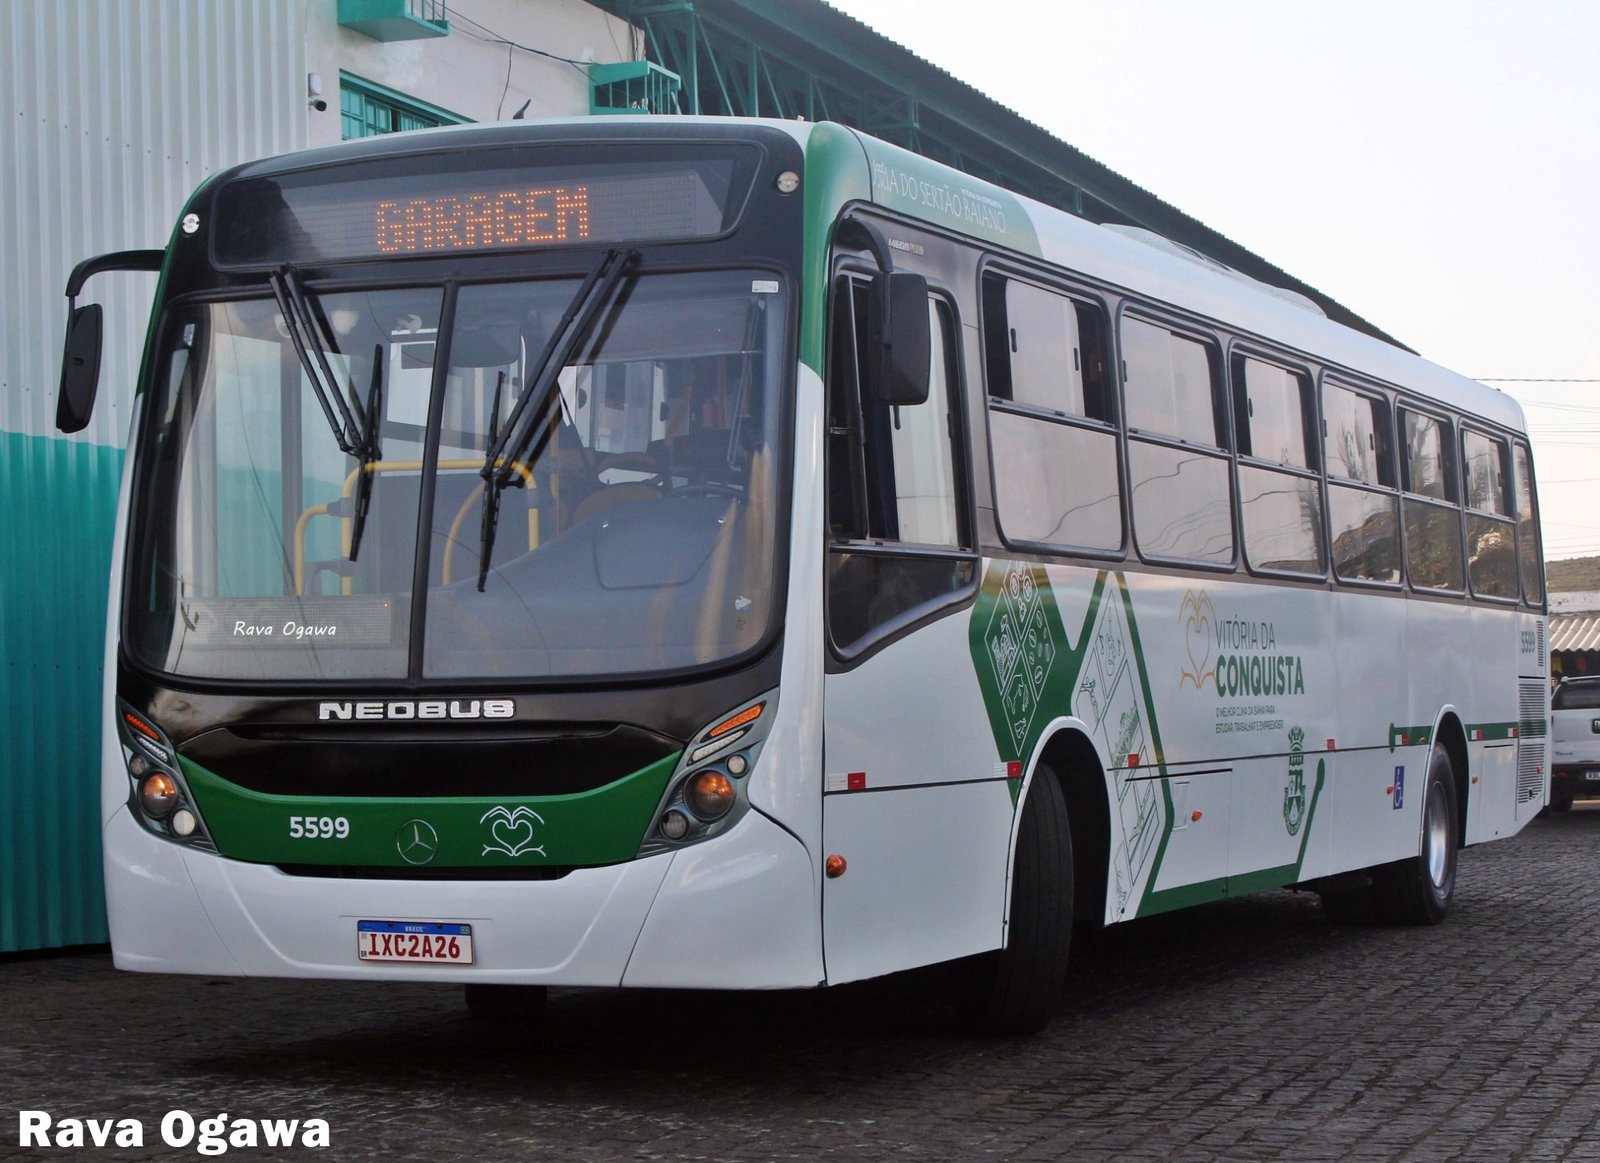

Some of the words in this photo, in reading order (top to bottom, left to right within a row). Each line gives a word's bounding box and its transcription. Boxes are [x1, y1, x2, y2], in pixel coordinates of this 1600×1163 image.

[900, 172, 918, 201] DO
[920, 181, 962, 217] SERTÃO
[964, 197, 1006, 234] BAIANO
[376, 187, 588, 251] GARAGEM
[1215, 614, 1258, 650] VITÓRIA
[1261, 622, 1276, 650] DA
[1521, 631, 1536, 654] 5599
[1216, 654, 1305, 698] CONQUISTA
[319, 700, 515, 720] NEOBUS
[289, 816, 350, 839] 5599
[404, 925, 425, 933] BRASIL
[369, 933, 461, 959] IXC2A26
